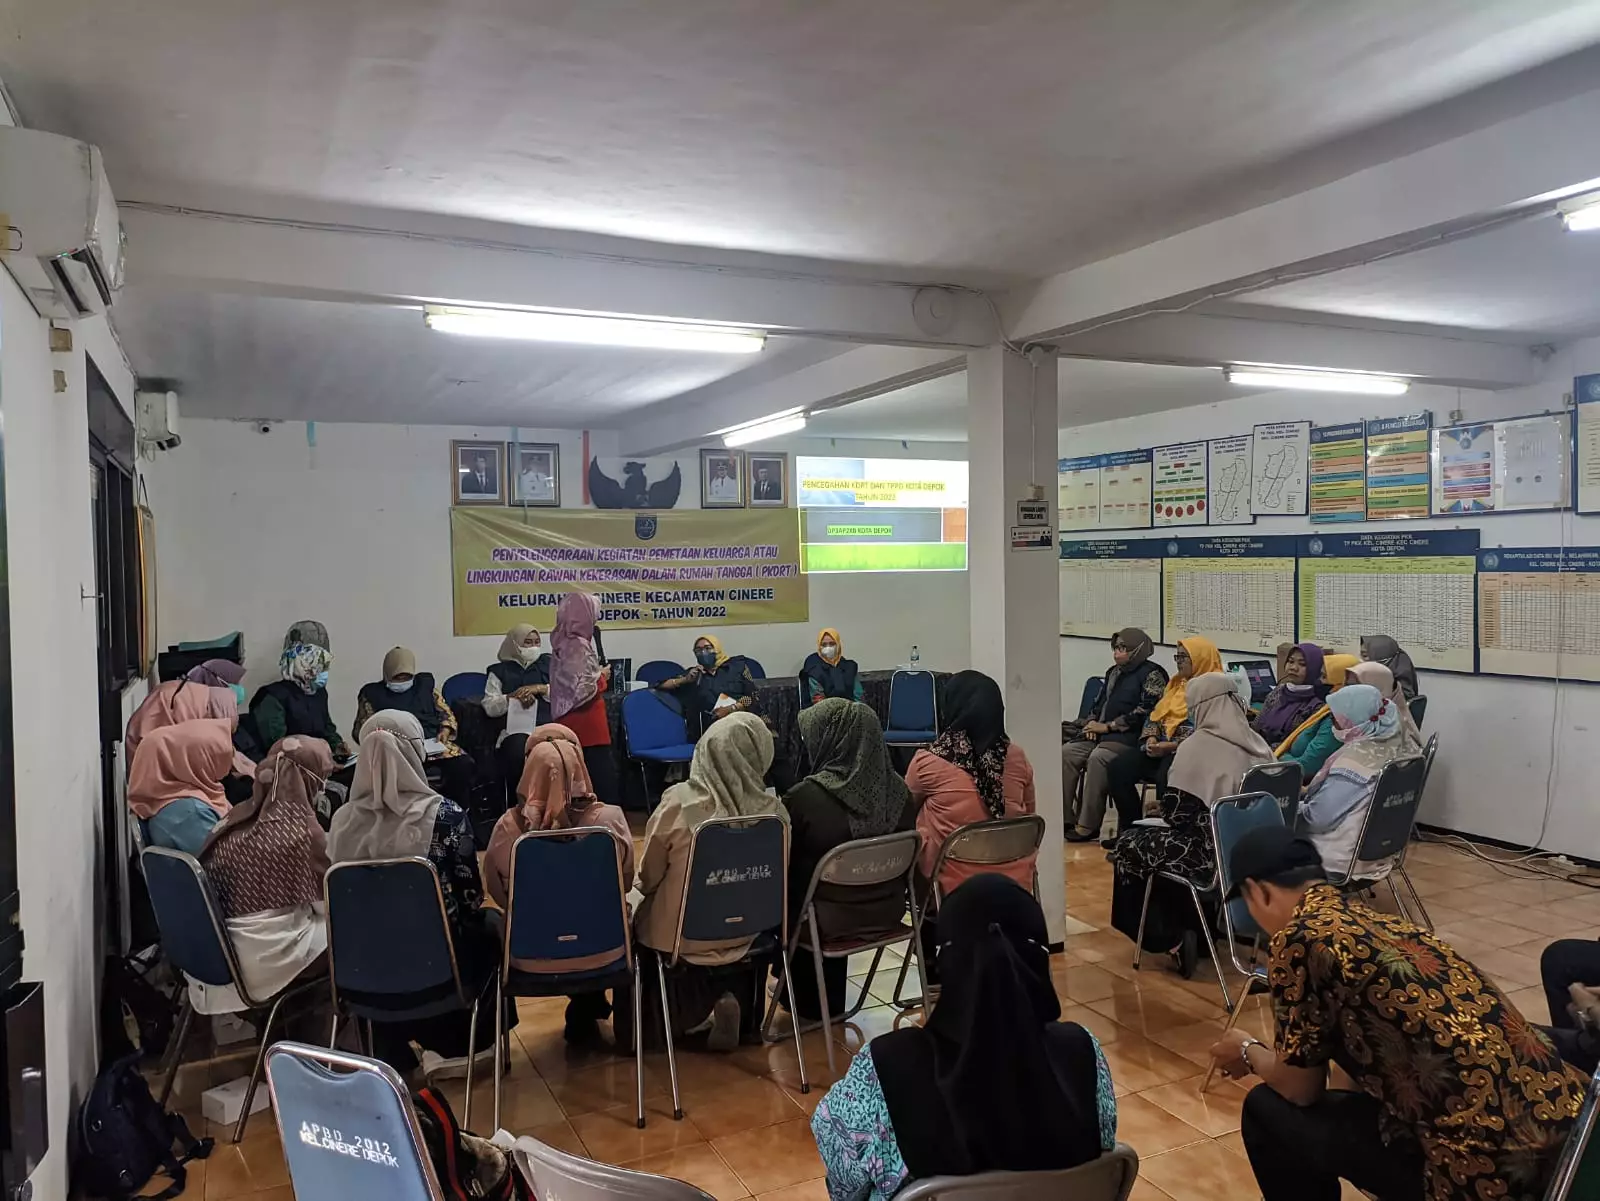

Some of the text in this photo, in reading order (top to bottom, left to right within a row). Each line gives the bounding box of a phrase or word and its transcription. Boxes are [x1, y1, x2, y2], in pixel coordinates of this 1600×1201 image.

[803, 480, 850, 489] PENCEGAHAN
[923, 483, 945, 491] DEPOK
[856, 493, 879, 501] TAHUN
[492, 546, 778, 561] PENYELENGGARAAN KEGIATAN PEMETAAN KELUARGA ATAU
[467, 569, 536, 584] LINGKUNGAN
[538, 569, 577, 582] RAWAN
[579, 568, 640, 582] KEKERASAN
[641, 568, 677, 580] DALAM
[679, 566, 714, 580] RUMAH
[716, 566, 752, 578] TANGGA
[499, 588, 774, 607] KELURAH INERE KECAMATAN CINERE
[598, 608, 641, 620] DEPOK
[651, 607, 694, 620] TAHUN
[698, 606, 726, 618] 2022
[302, 1121, 392, 1155] APBD 2012
[363, 1148, 400, 1168] DEPOK
